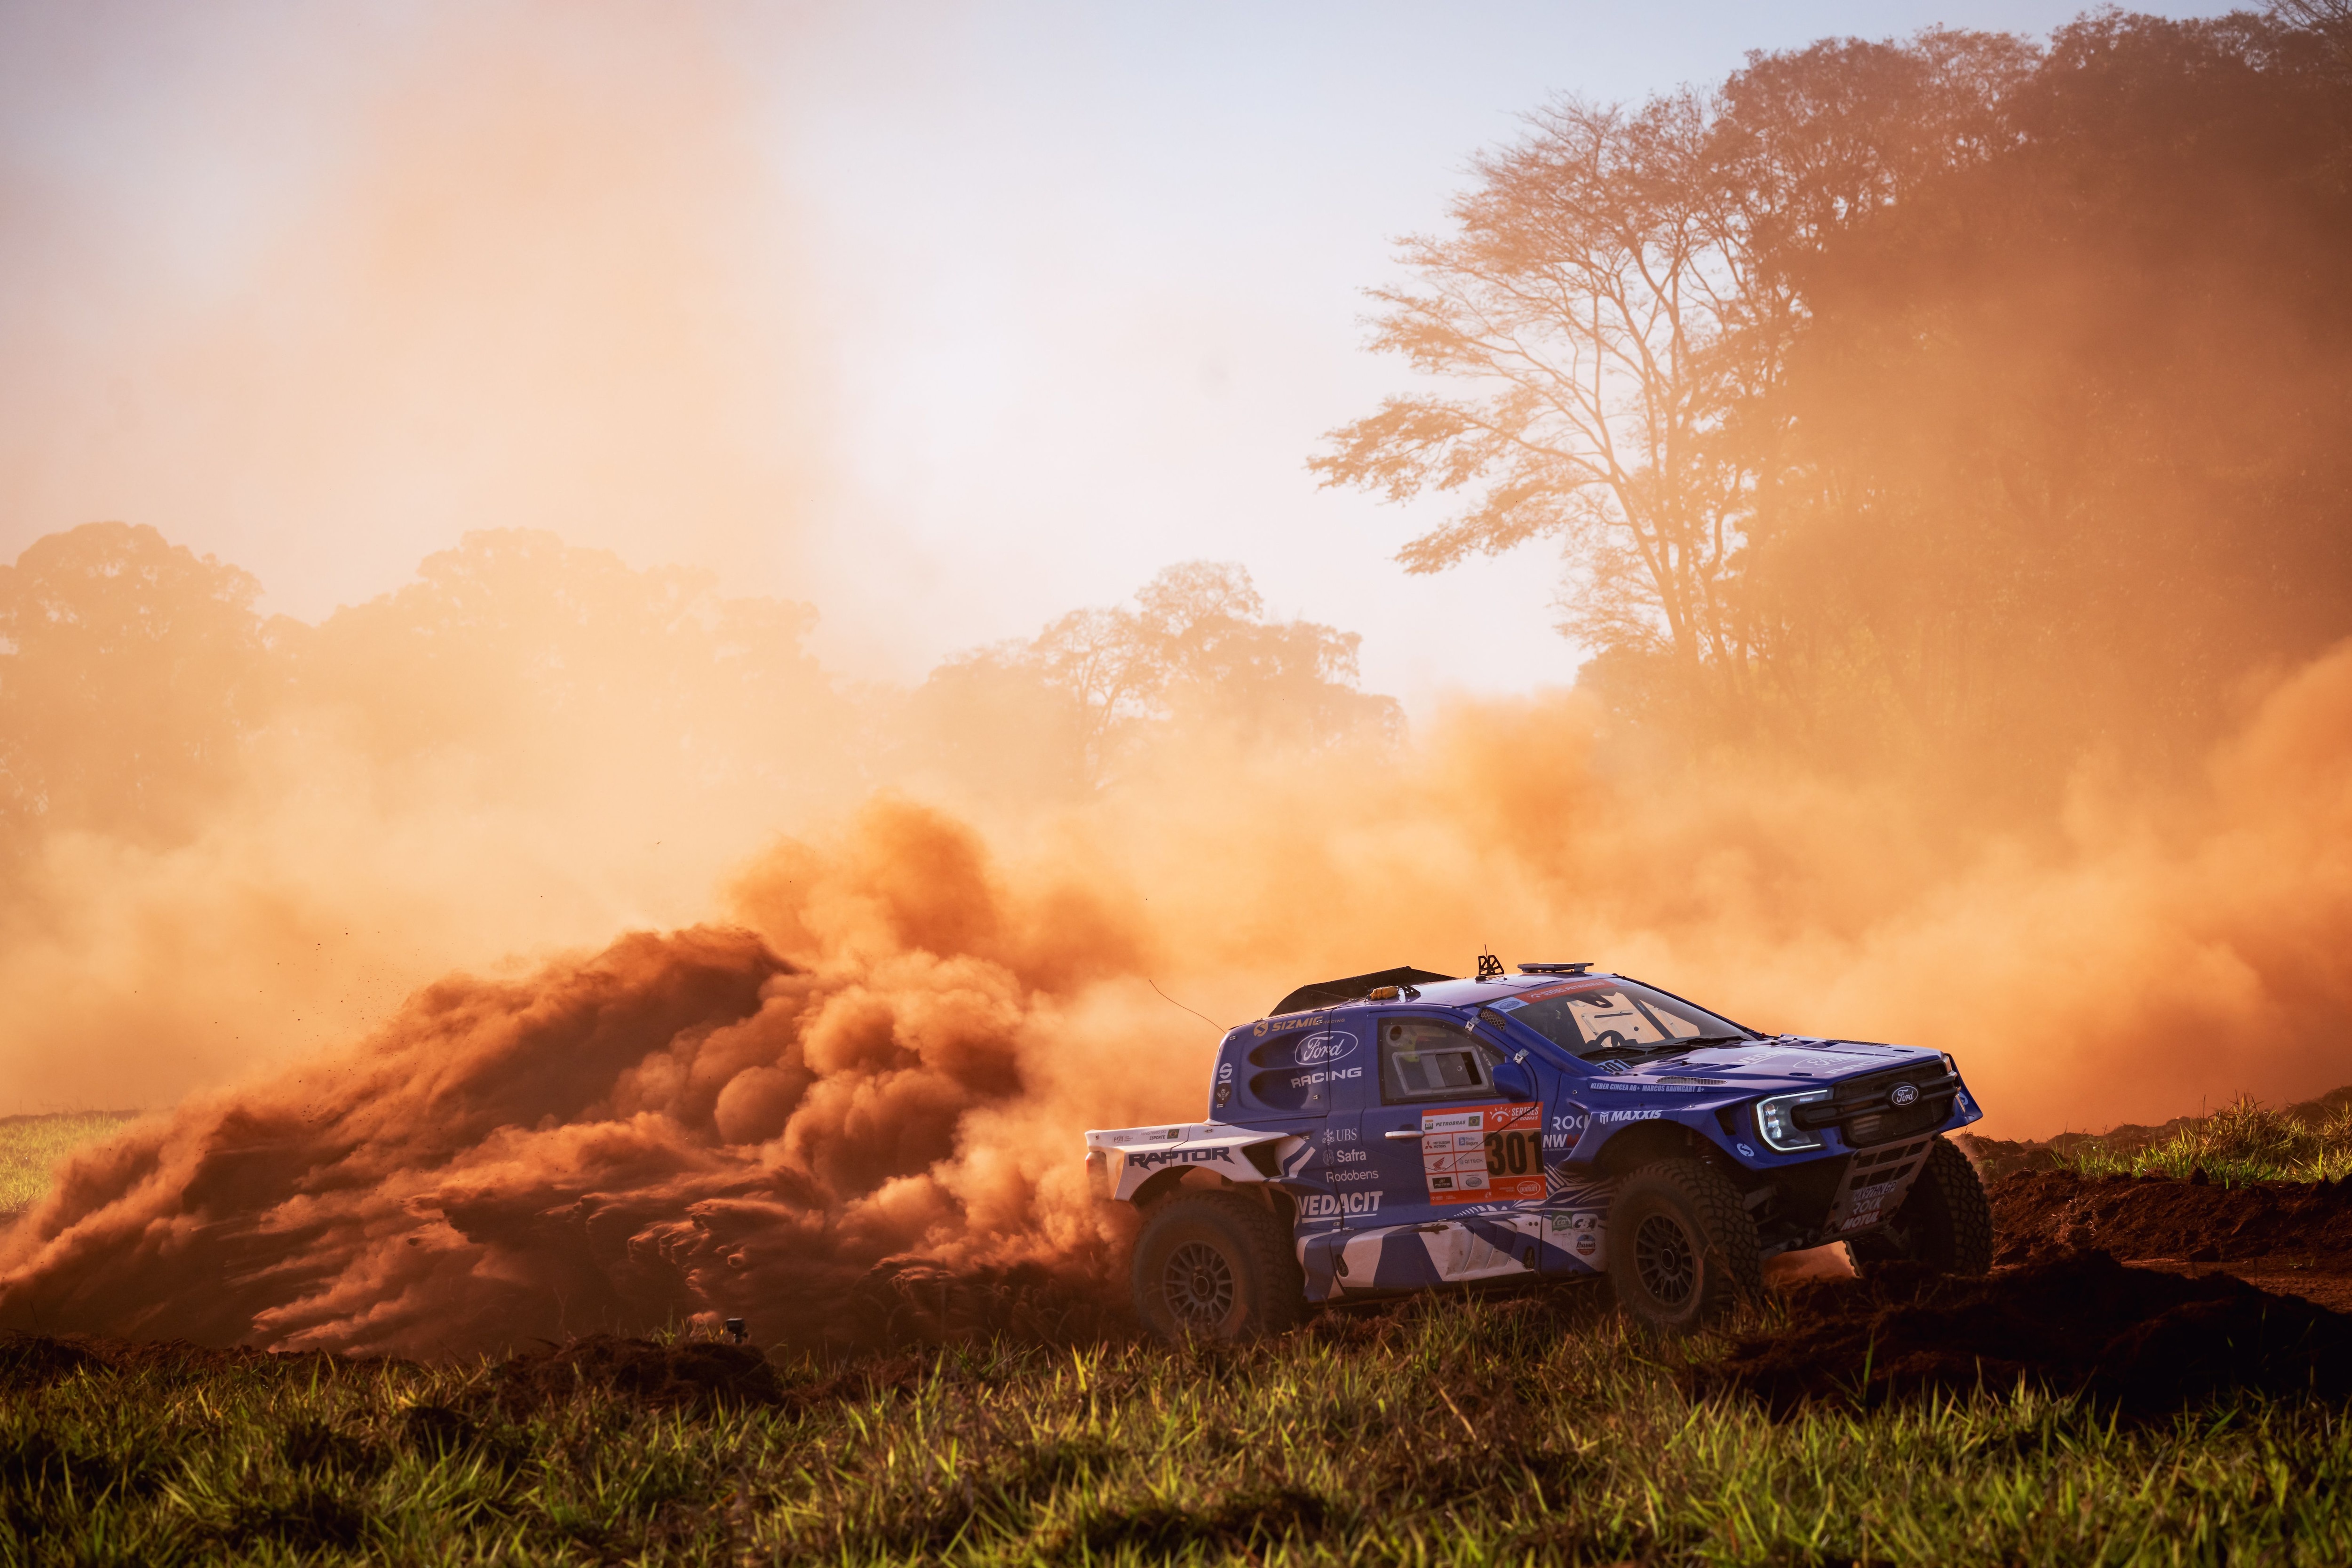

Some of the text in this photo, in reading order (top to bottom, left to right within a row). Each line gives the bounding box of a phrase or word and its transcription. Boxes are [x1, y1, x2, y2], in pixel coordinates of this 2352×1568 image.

[1303, 1035, 1345, 1061] Ford
[1290, 1067, 1362, 1089] RACING
[1897, 1088, 1914, 1103] Ford
[1511, 1106, 1539, 1116] SERTÕES
[1611, 1110, 1663, 1122] MAXXIS
[1336, 1128, 1358, 1142] UBS
[1128, 1146, 1235, 1171] RAPTOR
[1336, 1149, 1367, 1163] Safra
[1485, 1131, 1544, 1176] 301
[1326, 1170, 1379, 1183] Rodobens
[1520, 1185, 1538, 1193] podium
[1884, 1181, 1897, 1193] GP
[1297, 1191, 1383, 1216] VEDACIT
[1840, 1211, 1880, 1231] MOTUL
